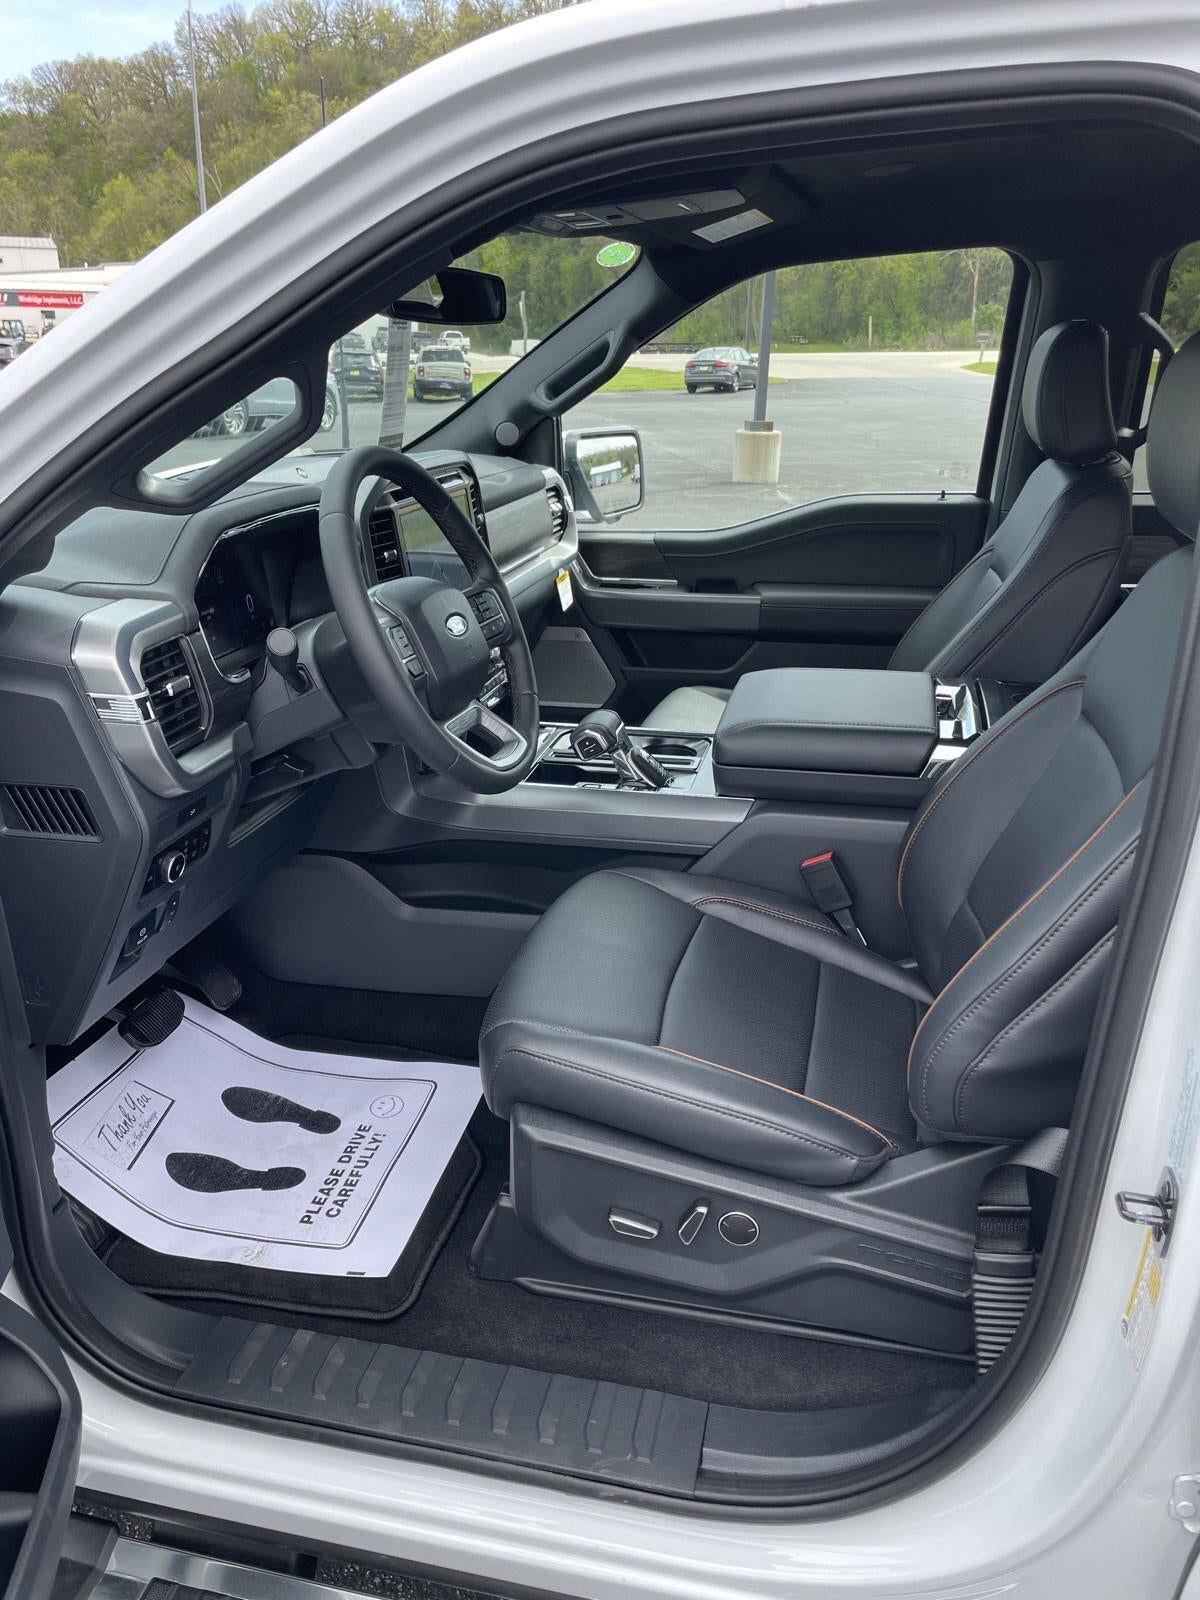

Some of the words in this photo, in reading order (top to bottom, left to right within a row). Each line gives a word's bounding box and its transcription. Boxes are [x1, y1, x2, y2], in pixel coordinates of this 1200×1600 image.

[98, 1105, 136, 1151] Thank
[124, 1092, 151, 1115] You
[299, 1168, 345, 1224] PLEASE
[337, 1124, 372, 1164] DRIVE
[325, 1133, 387, 1218] CAREFULLY!
